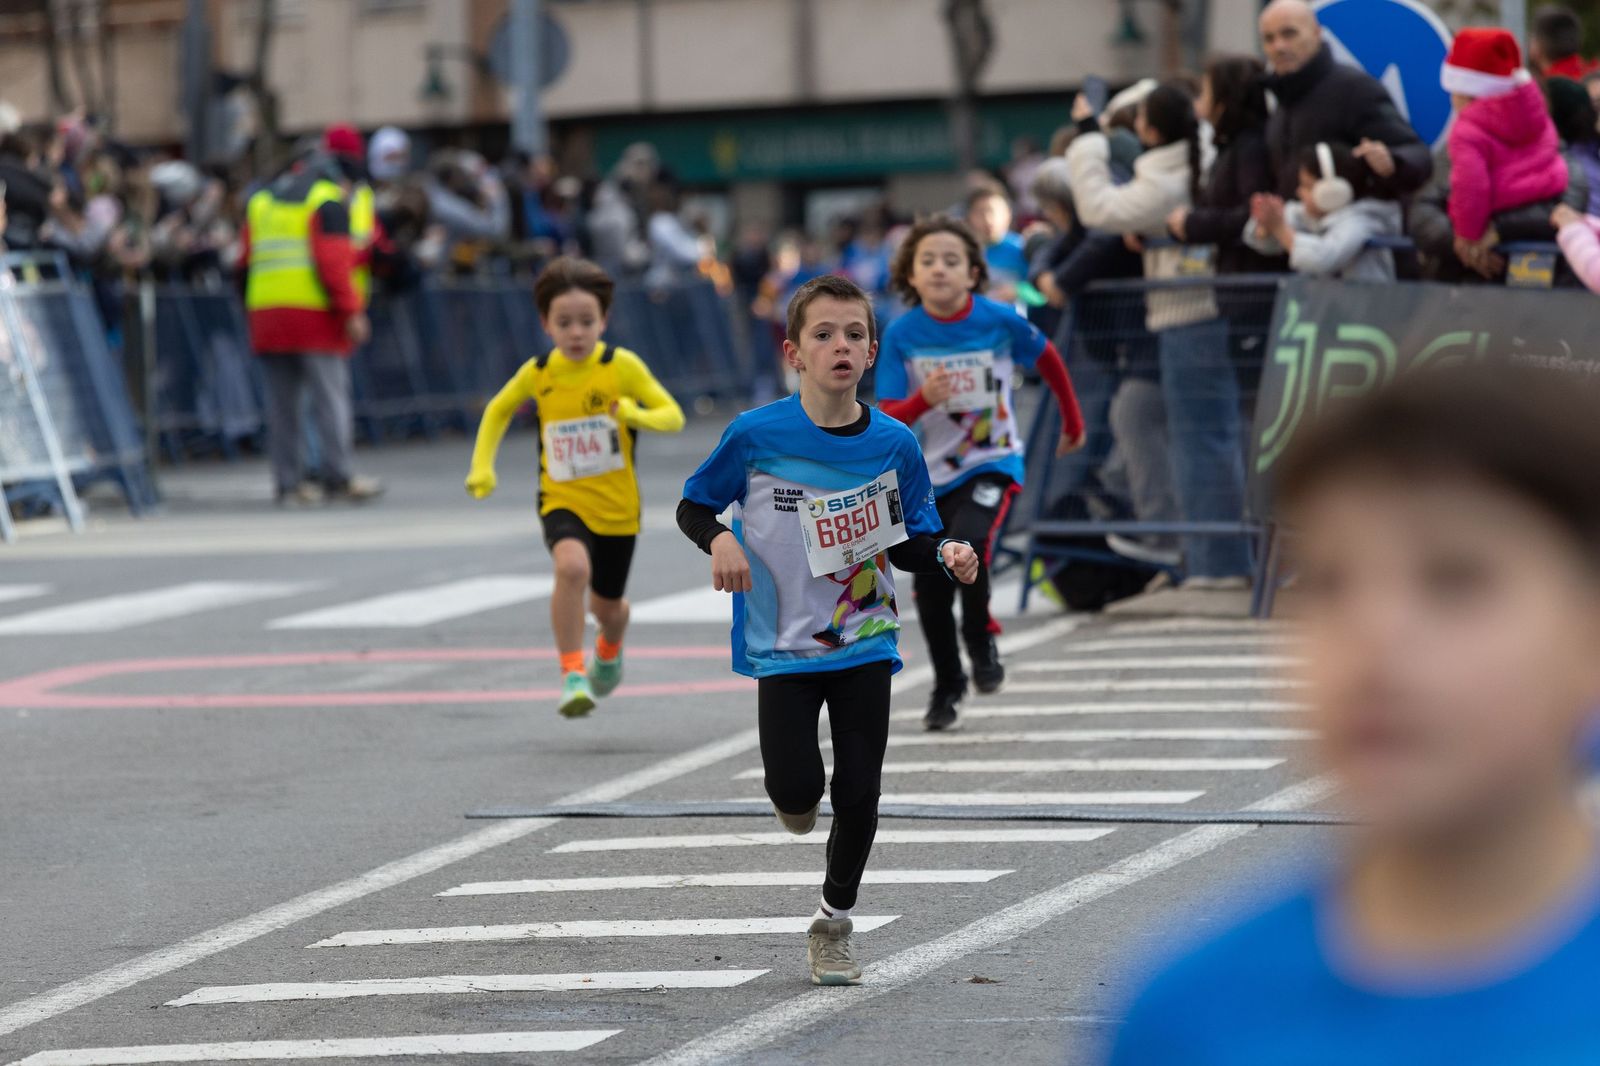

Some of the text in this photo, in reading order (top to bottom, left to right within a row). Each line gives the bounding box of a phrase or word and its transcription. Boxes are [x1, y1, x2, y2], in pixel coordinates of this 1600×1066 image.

[949, 370, 975, 395] 25
[553, 433, 602, 462] 6744
[774, 496, 804, 504] SILVES
[774, 504, 799, 513] SALMA
[827, 481, 888, 513] SETEL
[815, 499, 880, 549] 6850
